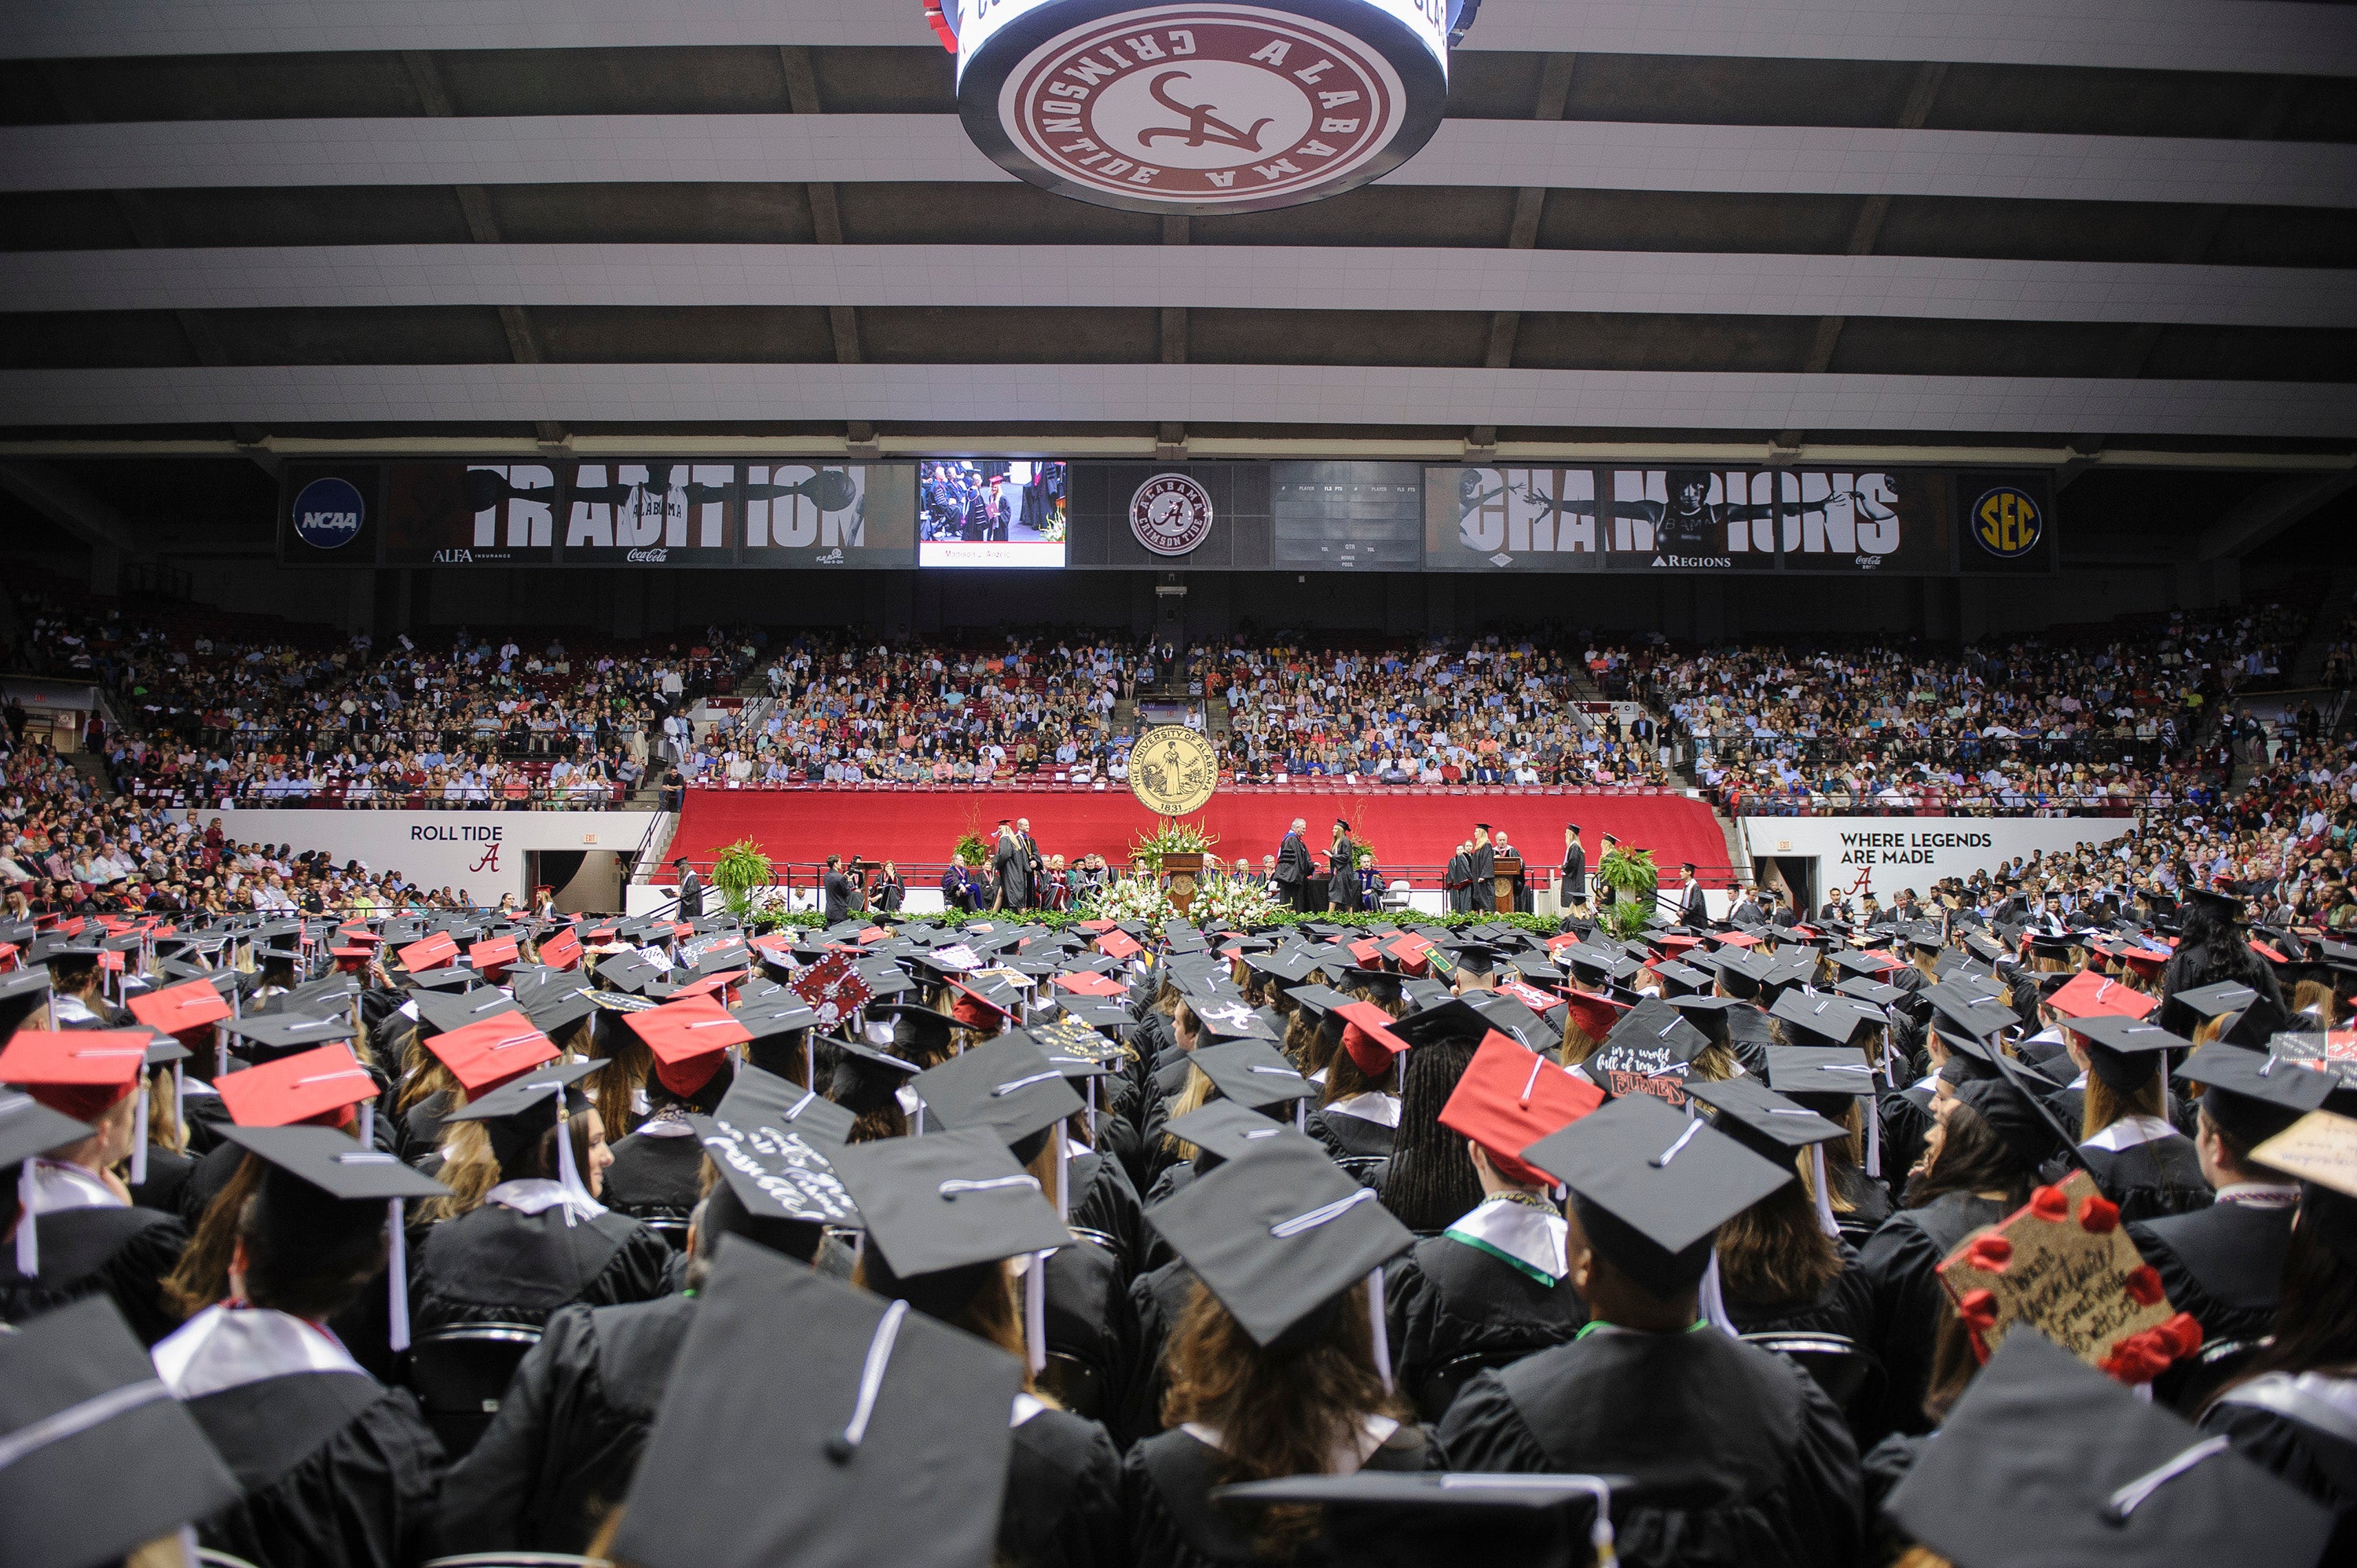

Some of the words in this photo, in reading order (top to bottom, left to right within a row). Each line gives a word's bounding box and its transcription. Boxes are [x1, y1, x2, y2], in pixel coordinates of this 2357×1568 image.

[1043, 29, 1197, 134] CRIMSON
[1204, 39, 1361, 189] ALABAMA
[1061, 139, 1160, 185] TIDE
[1140, 482, 1204, 511] ALABAMA
[1459, 468, 1901, 555] CHAMIONS
[302, 511, 358, 530] NCAA
[1139, 517, 1181, 548] CRIMSON
[1182, 518, 1203, 542] TIDE
[1979, 493, 2036, 551] SEC
[432, 549, 473, 562] ALFA
[1134, 731, 1183, 764] UNIVERSITY
[1185, 733, 1197, 742] OF
[1197, 743, 1214, 791] ALABAMA
[411, 826, 458, 841] ROLL
[461, 826, 503, 841] TIDE
[1840, 833, 1904, 848] WHERE
[1911, 833, 1992, 848] LEGENDS
[1841, 850, 1876, 864] ARE
[1882, 850, 1934, 864] MADE
[1596, 1053, 1619, 1071] full
[1621, 1056, 1634, 1072] of
[1611, 1046, 1625, 1058] in
[1627, 1048, 1635, 1057] a
[1638, 1047, 1670, 1063] world
[1609, 1070, 1686, 1105] ELEVEN
